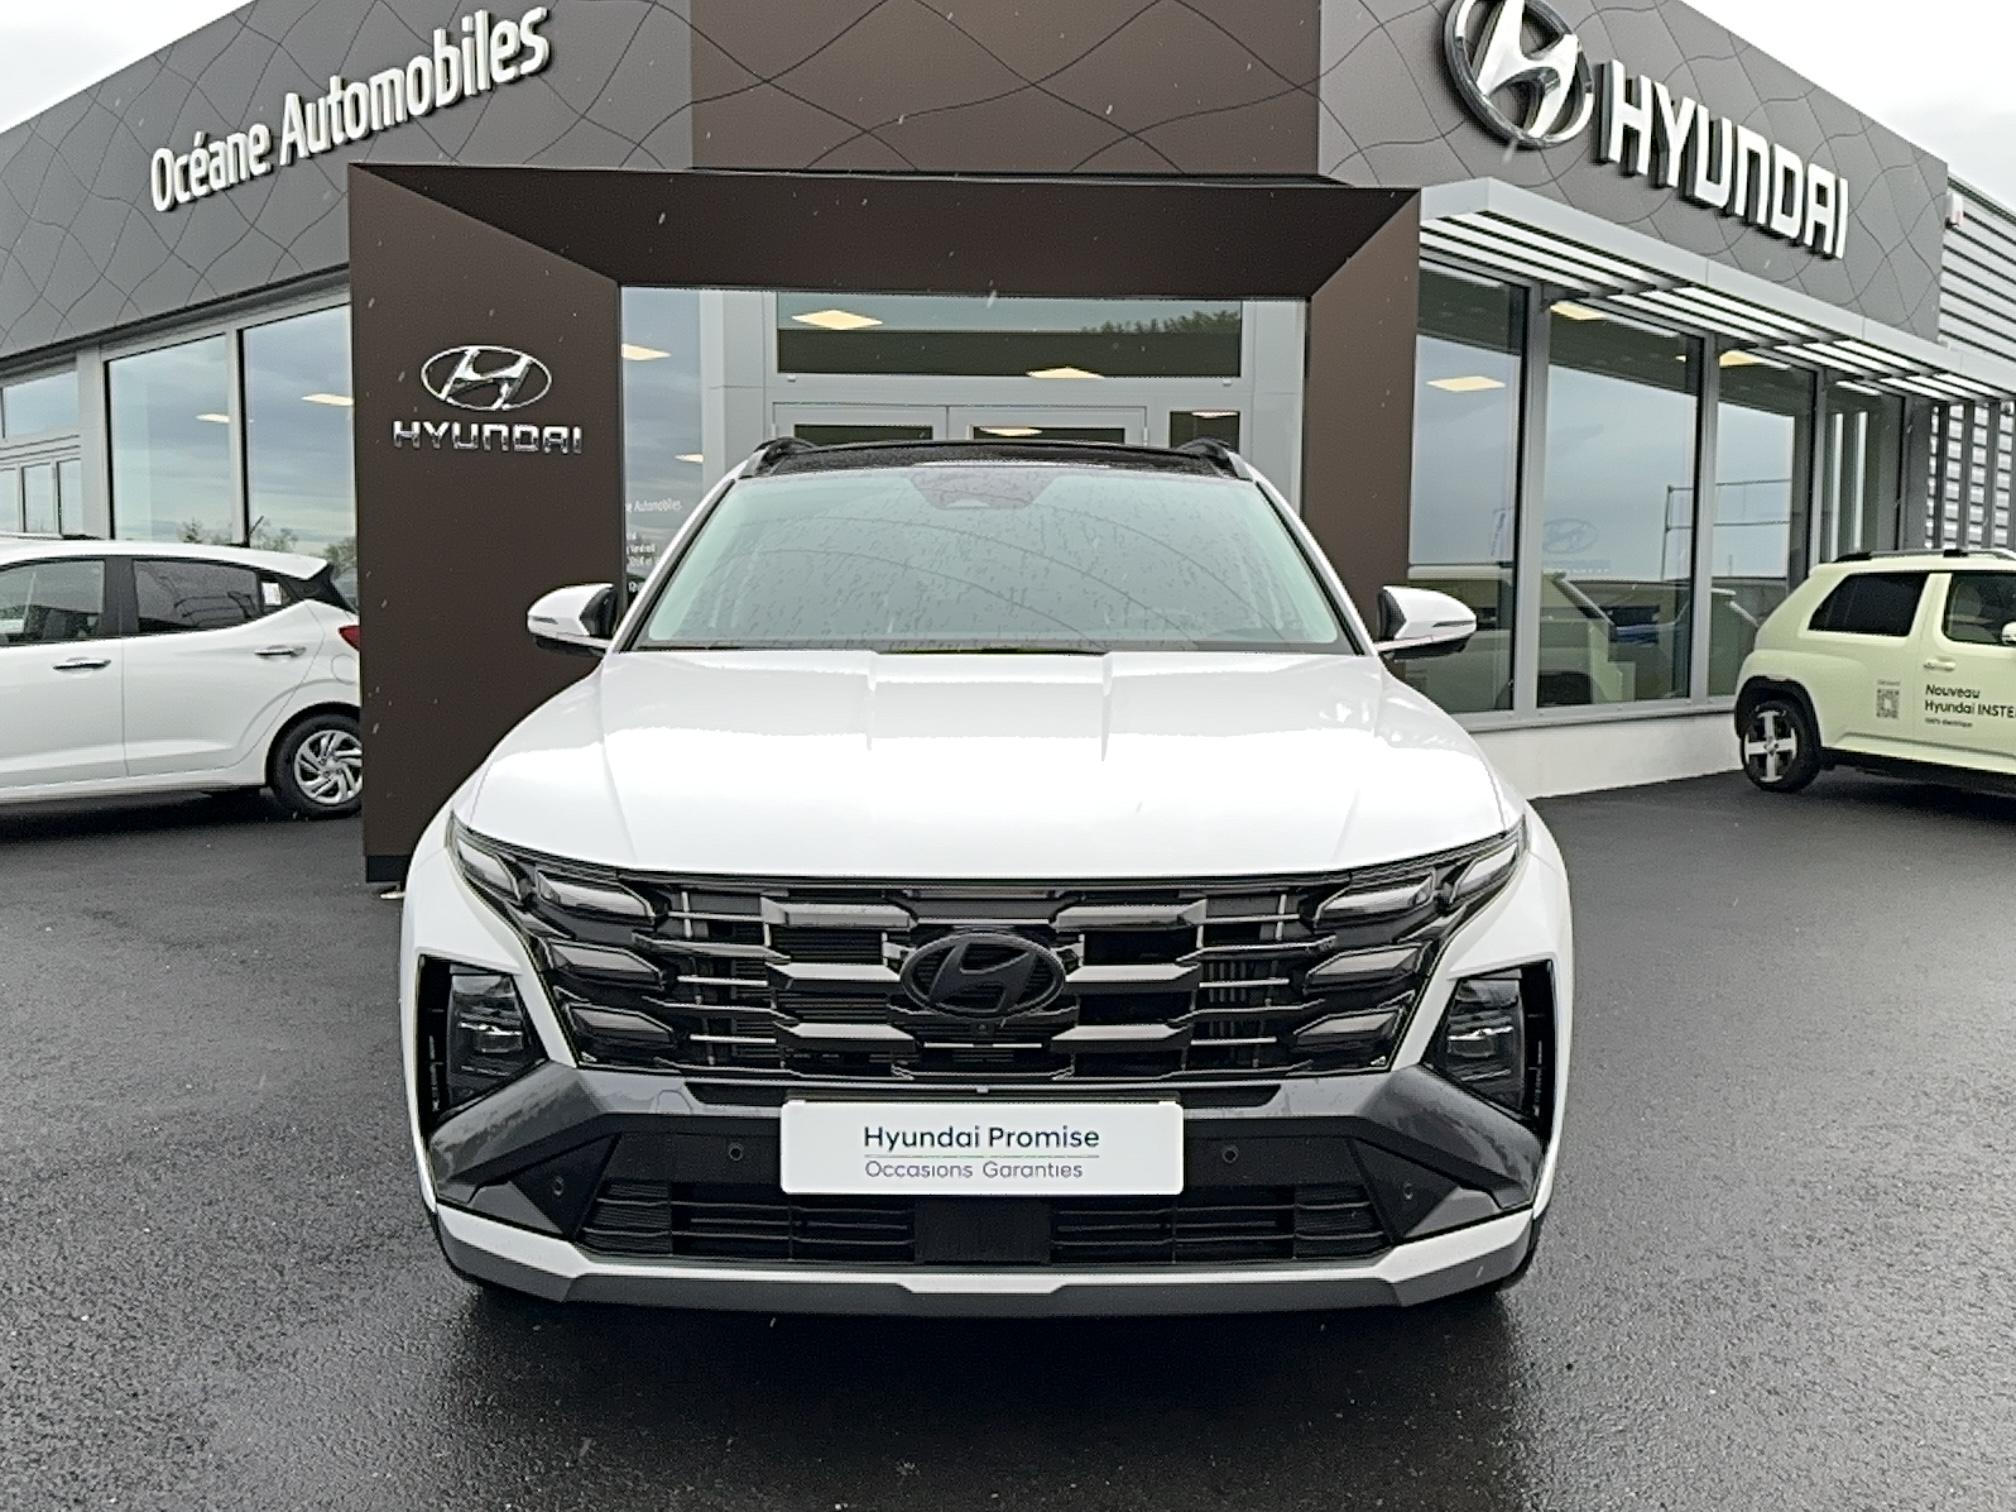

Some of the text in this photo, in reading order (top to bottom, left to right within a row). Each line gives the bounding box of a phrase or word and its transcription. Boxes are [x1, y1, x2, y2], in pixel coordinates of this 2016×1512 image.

[151, 6, 551, 212] Océane Automobiles
[1599, 58, 1850, 260] HYUNDAI
[393, 420, 582, 454] HYUNDAI
[1925, 684, 1981, 699] Nouveau
[1924, 700, 2016, 718] Hyundai INSTE
[864, 1125, 1100, 1152] Hyundai Promise
[865, 1160, 1083, 1178] Occasions Garanties
